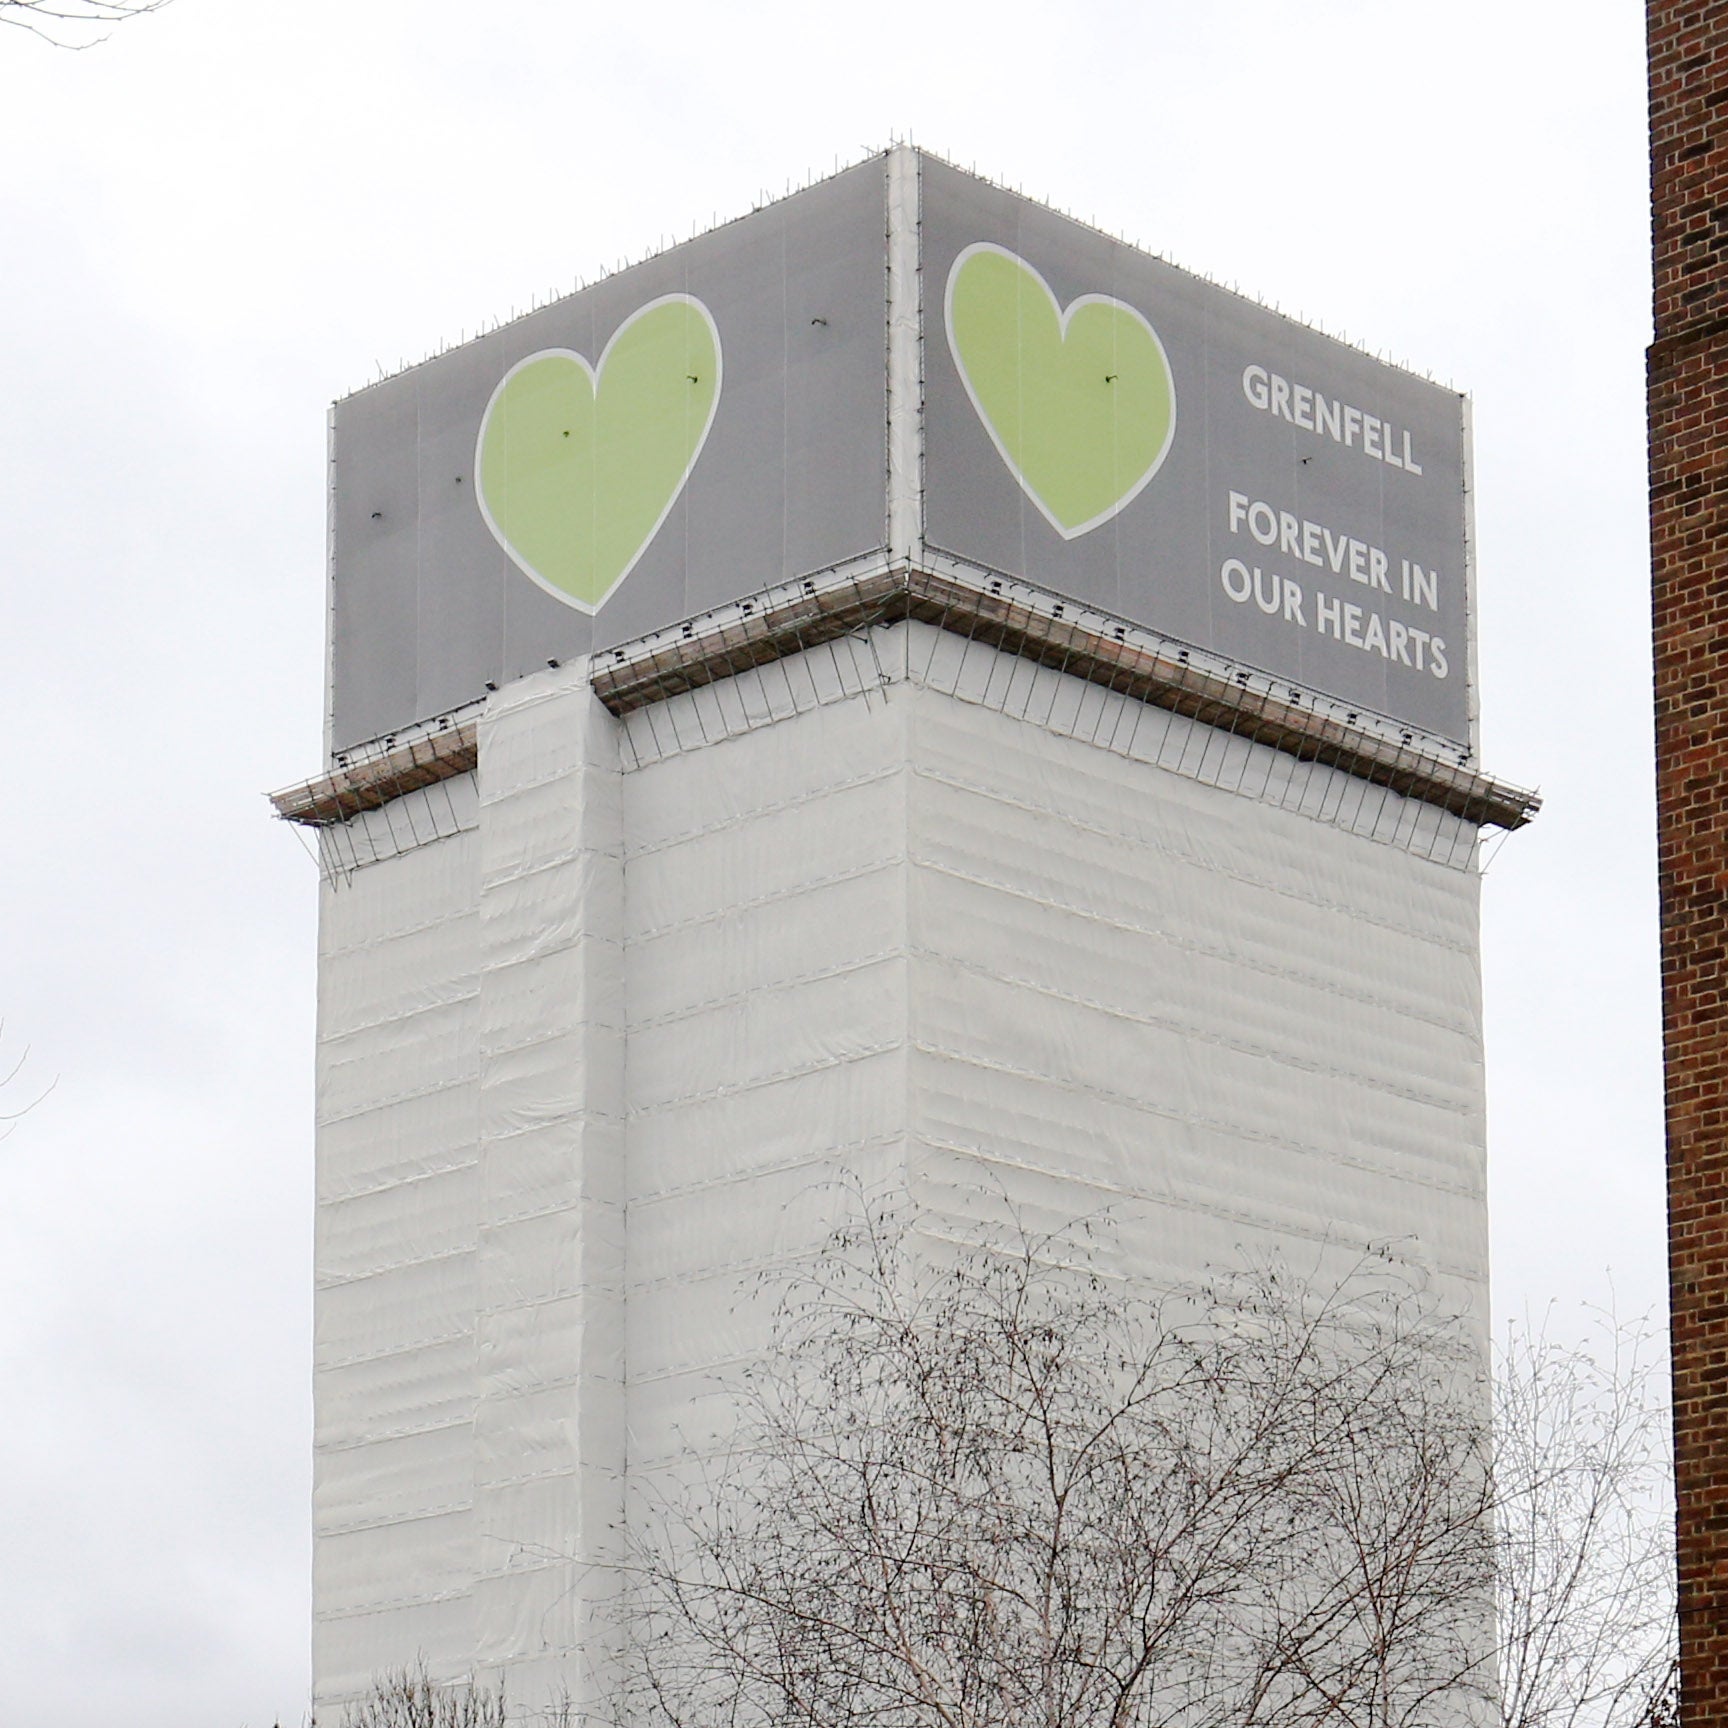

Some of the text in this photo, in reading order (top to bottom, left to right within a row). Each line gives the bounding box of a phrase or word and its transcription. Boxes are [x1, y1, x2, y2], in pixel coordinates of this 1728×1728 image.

[1242, 364, 1423, 475] GRENFELL
[1229, 490, 1438, 612] FOREVER IN
[1221, 558, 1449, 679] OUR HEARTS
